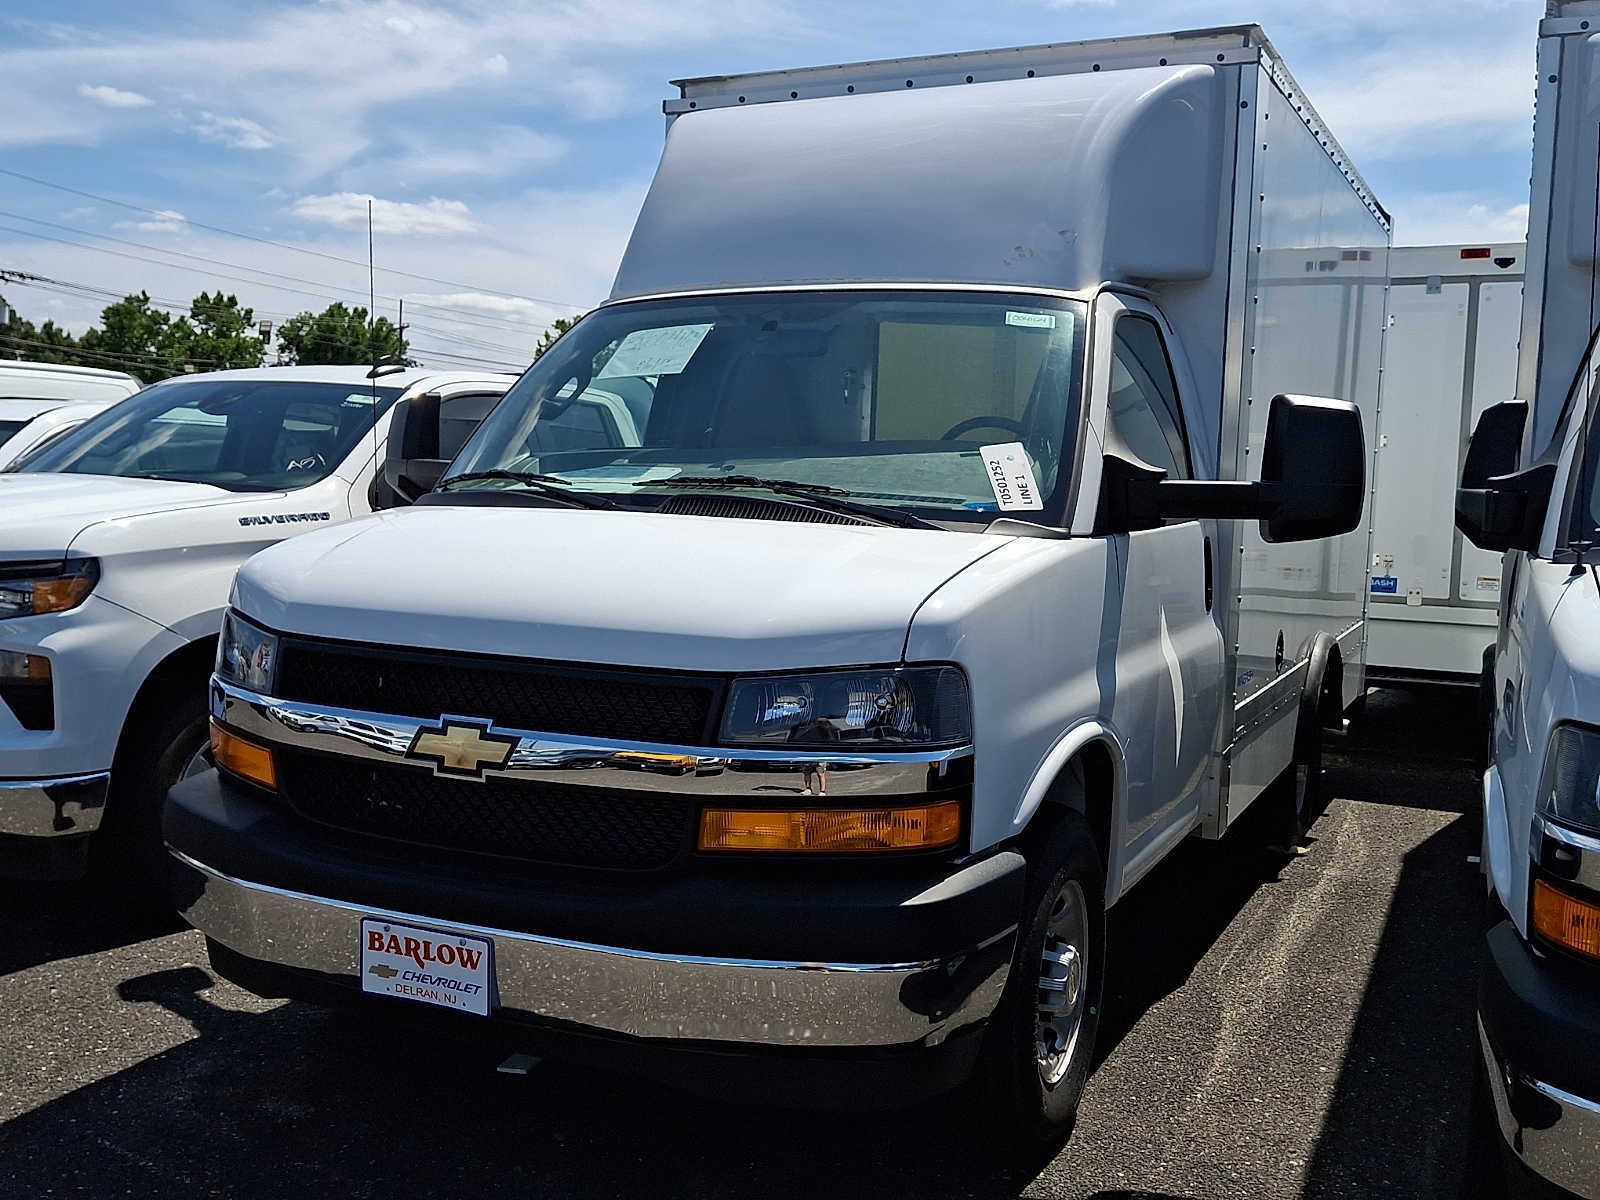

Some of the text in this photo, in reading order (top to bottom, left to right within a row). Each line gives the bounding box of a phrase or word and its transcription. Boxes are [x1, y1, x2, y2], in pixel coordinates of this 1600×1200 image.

[1017, 482, 1033, 505] LINE
[238, 512, 330, 526] SILVERADO
[367, 930, 483, 971] BARLOW
[395, 983, 457, 1005] DELRAN, NJ
[402, 970, 482, 995] CHEVROLET
